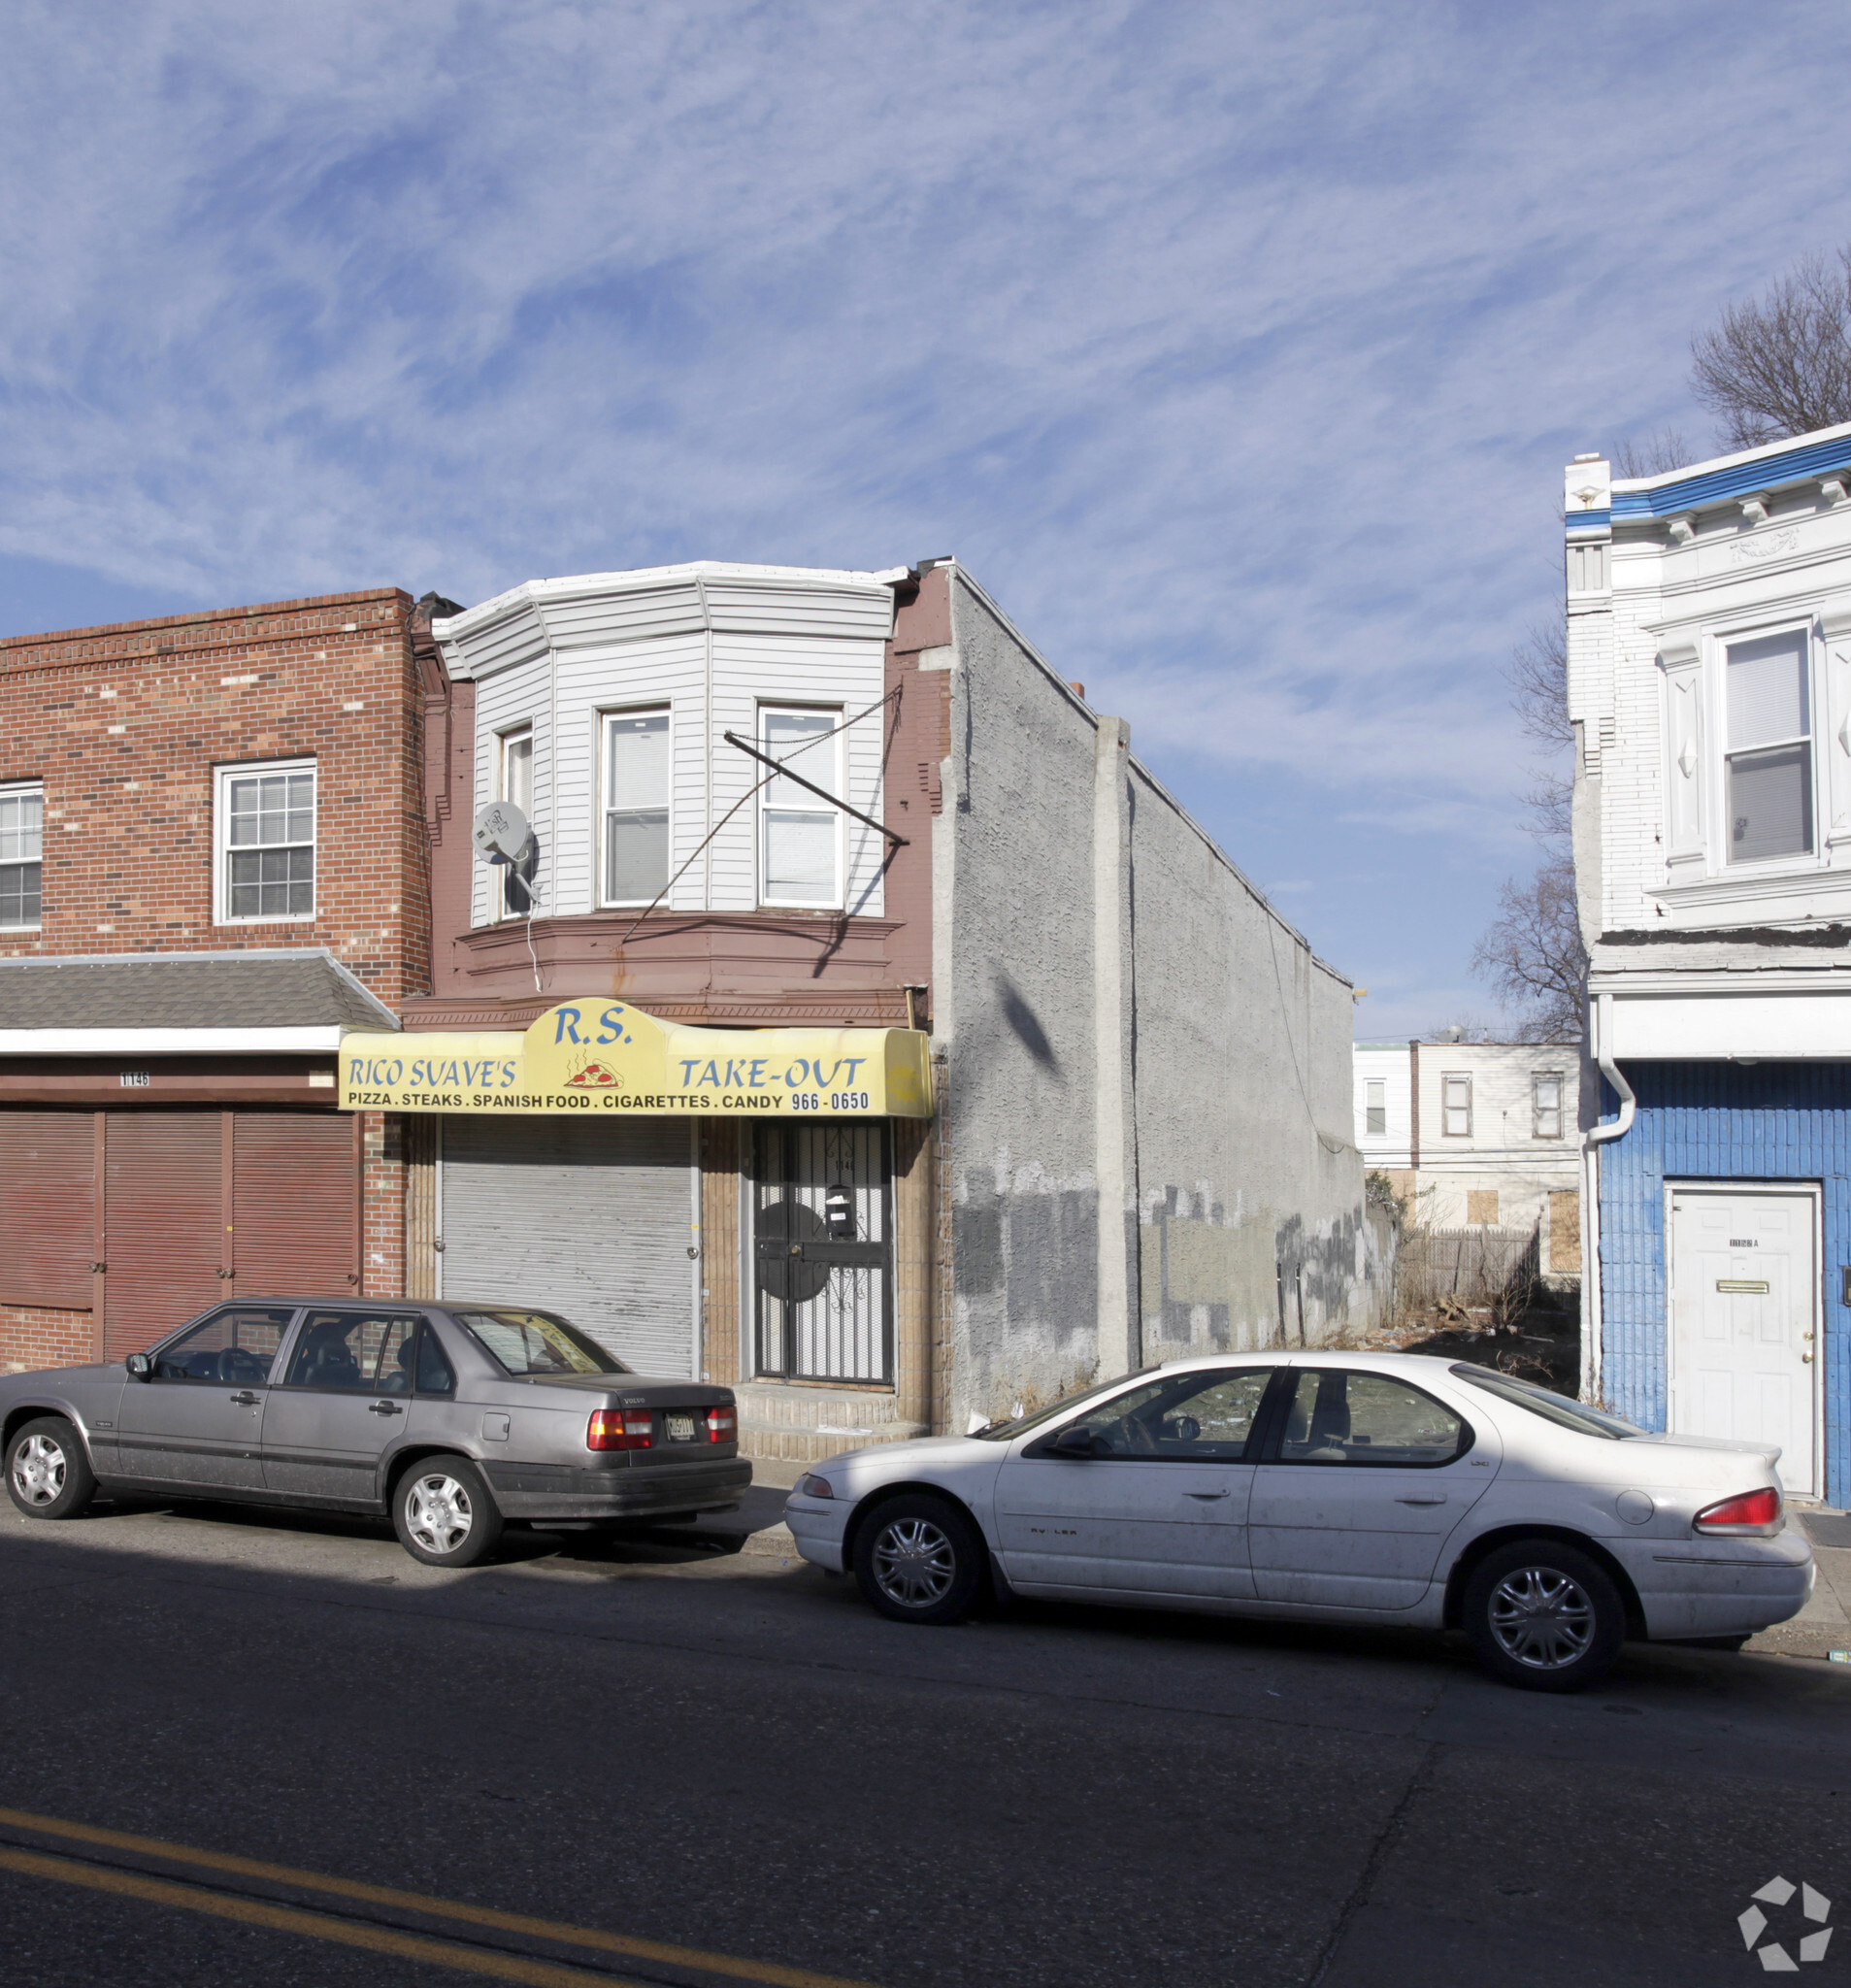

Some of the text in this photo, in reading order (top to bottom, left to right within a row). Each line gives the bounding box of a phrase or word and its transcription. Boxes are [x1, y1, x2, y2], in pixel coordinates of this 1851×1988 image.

[554, 1007, 632, 1044] R.S.
[120, 1072, 149, 1086] 1146
[349, 1059, 516, 1088] RICO SUAVE'S
[678, 1057, 868, 1088] TAKE-OUT
[348, 1092, 391, 1105] PIZZA
[402, 1093, 462, 1107] STEAKS
[473, 1094, 543, 1108] SPANISH
[546, 1095, 590, 1109] FOOD
[603, 1095, 711, 1109] CIGARETTES
[722, 1095, 783, 1109] CANDY
